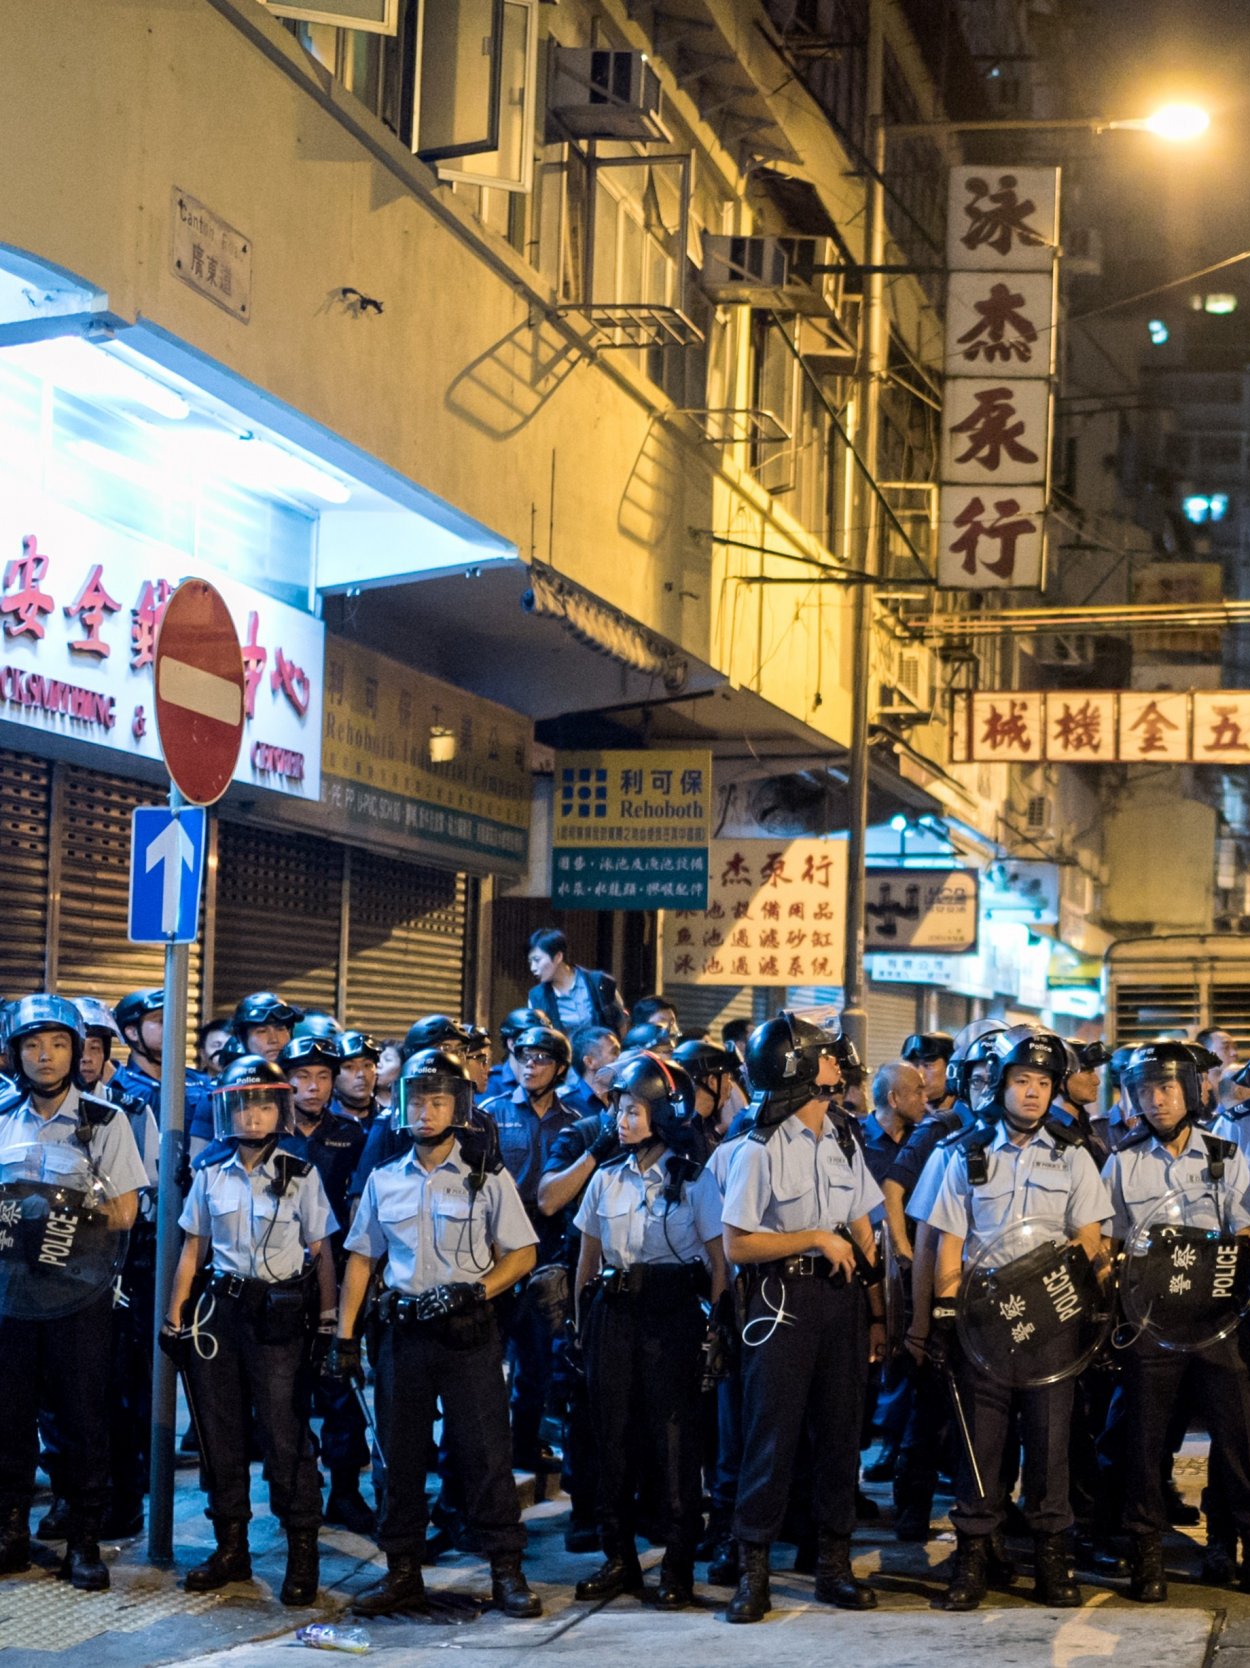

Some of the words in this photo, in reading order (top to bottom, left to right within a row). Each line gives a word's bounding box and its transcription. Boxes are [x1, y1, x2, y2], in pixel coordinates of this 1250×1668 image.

[619, 768, 703, 796] 利可保
[620, 801, 703, 818] Rehoboth
[710, 852, 835, 888] 杰泵行
[1028, 1042, 1053, 1053] Police
[236, 1076, 261, 1085] Police
[412, 1065, 437, 1075] Police
[38, 1211, 79, 1267] POLICE
[1169, 1243, 1197, 1295] 警察
[1211, 1245, 1239, 1298] POLICE
[1042, 1264, 1082, 1322] POLICE
[1000, 1294, 1035, 1343] 警察
